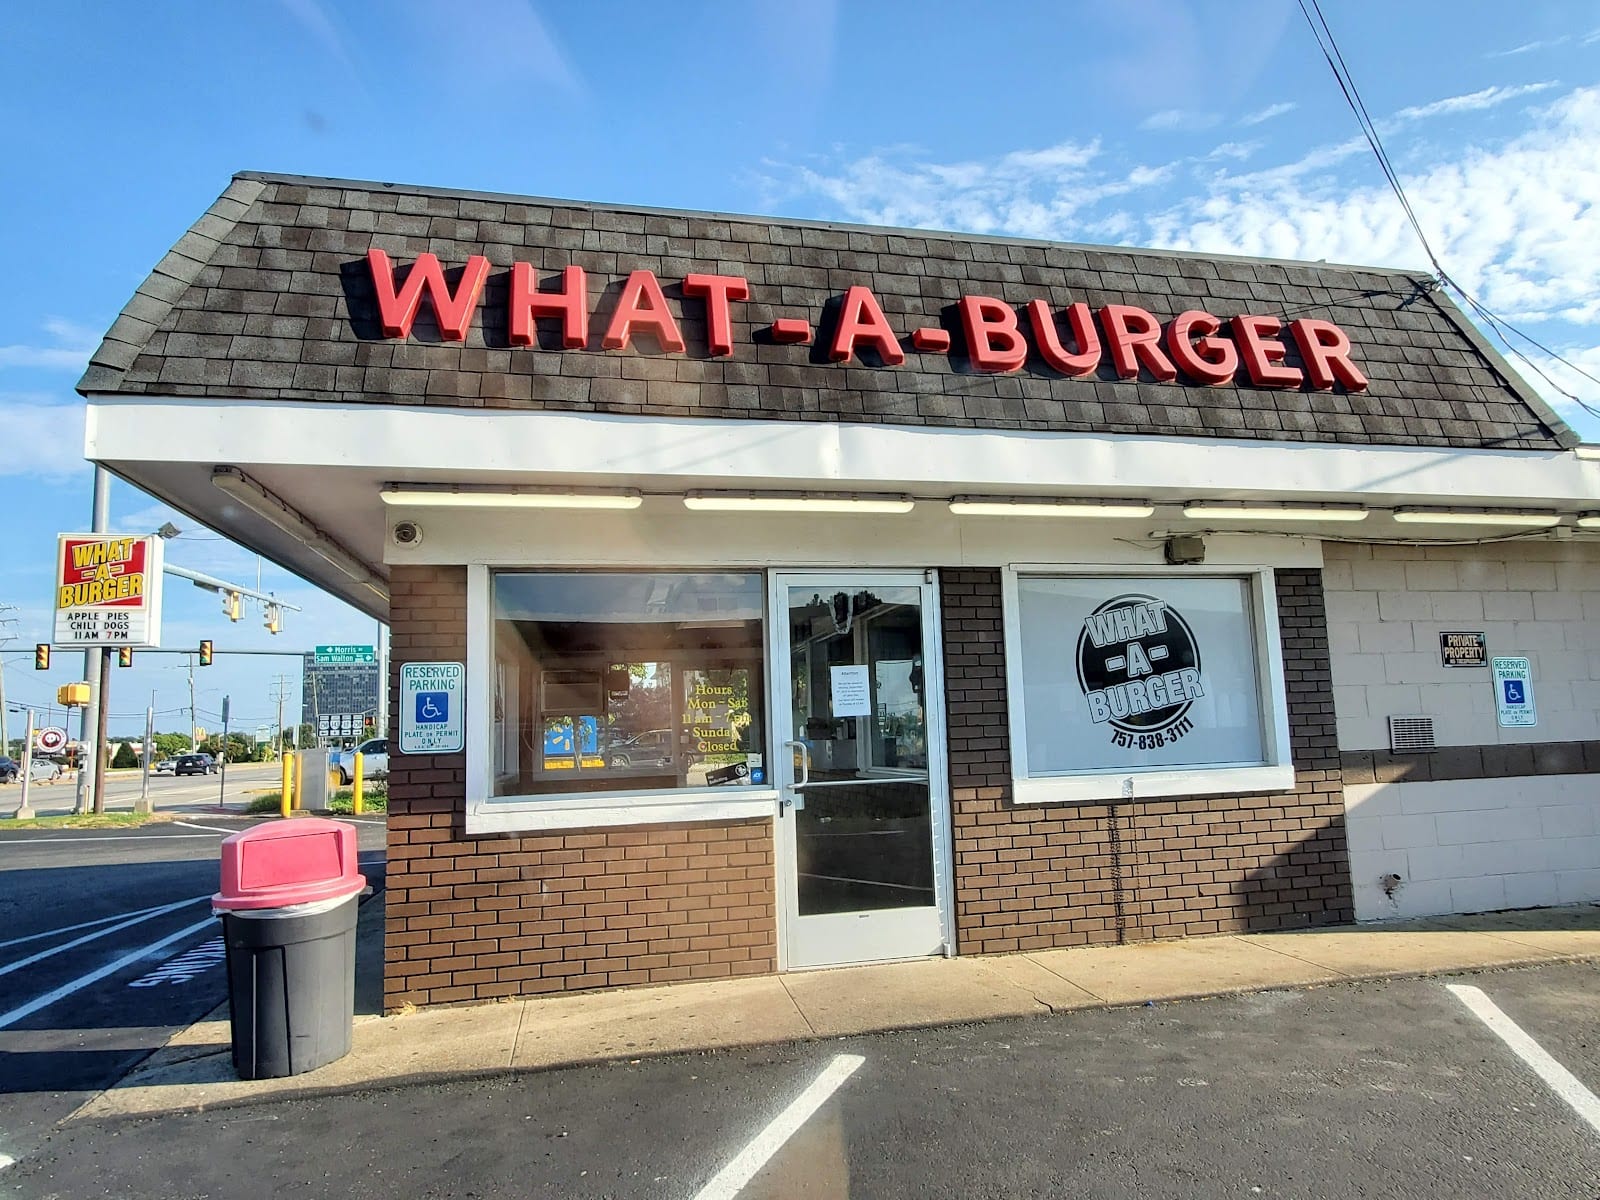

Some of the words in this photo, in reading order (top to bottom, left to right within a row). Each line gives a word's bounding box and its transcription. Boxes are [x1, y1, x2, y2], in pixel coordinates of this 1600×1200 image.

[72, 537, 134, 569] WHAT
[60, 573, 144, 609] BURGER
[67, 612, 99, 621] APPLE
[107, 612, 129, 620] PIES
[70, 621, 96, 630] CHILI
[104, 621, 129, 630] DOGS
[1084, 600, 1168, 648] WHAT
[1447, 635, 1478, 647] PRIVATE
[1444, 647, 1483, 658] PROPERTY
[1494, 661, 1527, 670] RESERVED
[405, 667, 459, 678] RESERVED
[1498, 670, 1526, 679] PARKING
[409, 679, 455, 690] PARKING
[695, 684, 733, 695] Hours
[1086, 666, 1205, 724] BURGER
[688, 698, 716, 709] Mon
[693, 727, 735, 740] Sunda
[1110, 716, 1194, 750] 757-838-3111
[698, 741, 737, 752] Closed
